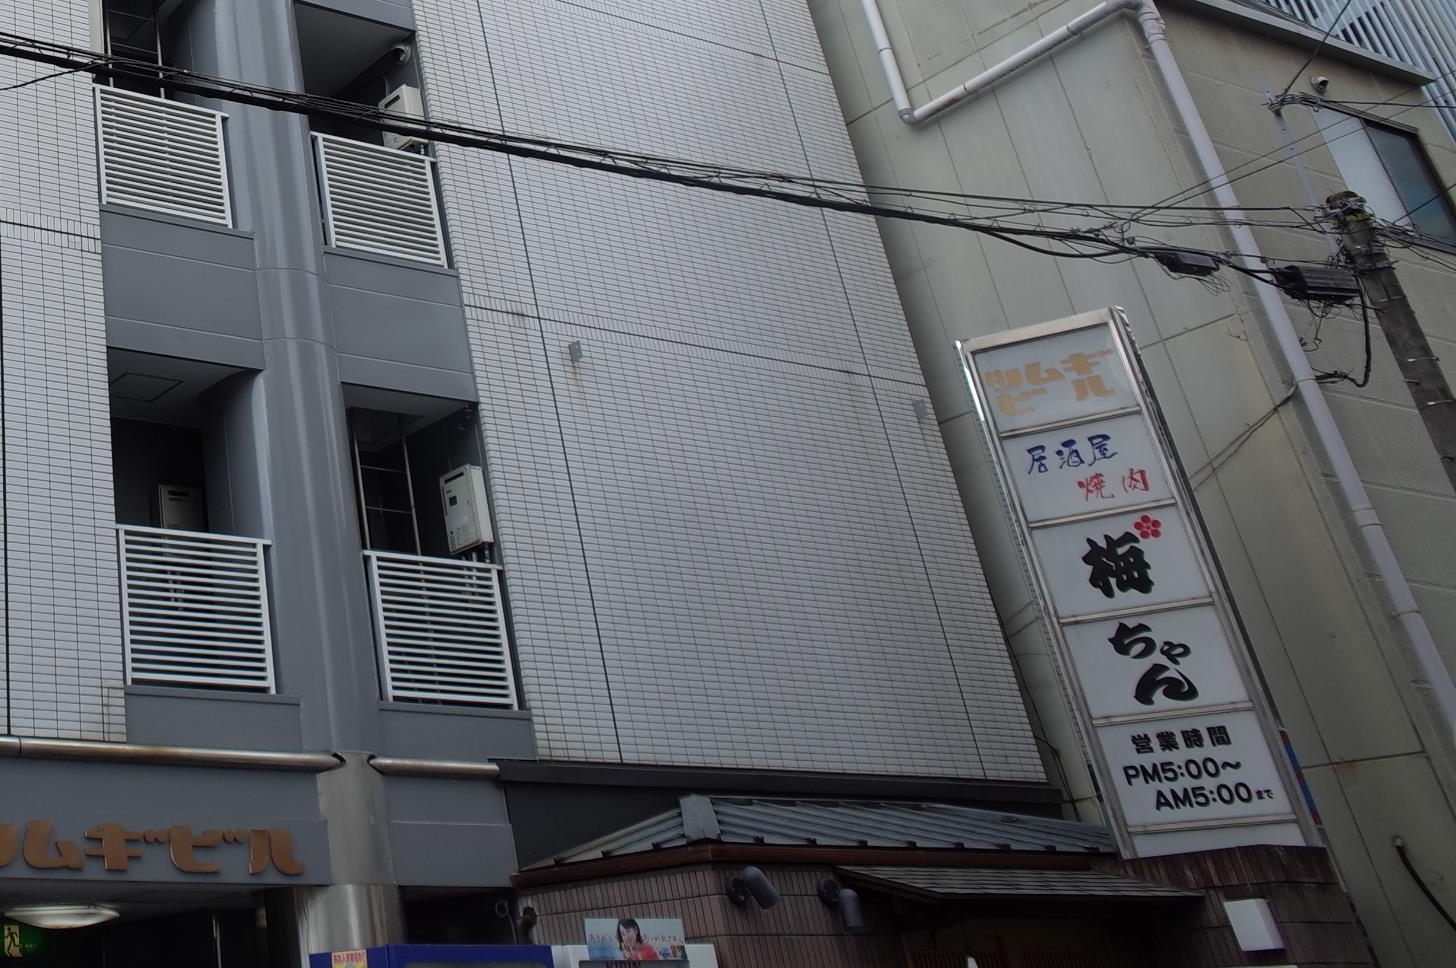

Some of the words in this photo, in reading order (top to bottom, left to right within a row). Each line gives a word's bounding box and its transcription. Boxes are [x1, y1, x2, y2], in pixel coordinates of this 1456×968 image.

[1027, 434, 1118, 475] 居酒屋
[1077, 468, 1149, 501] 焼肉
[1131, 725, 1232, 754] 営業時間
